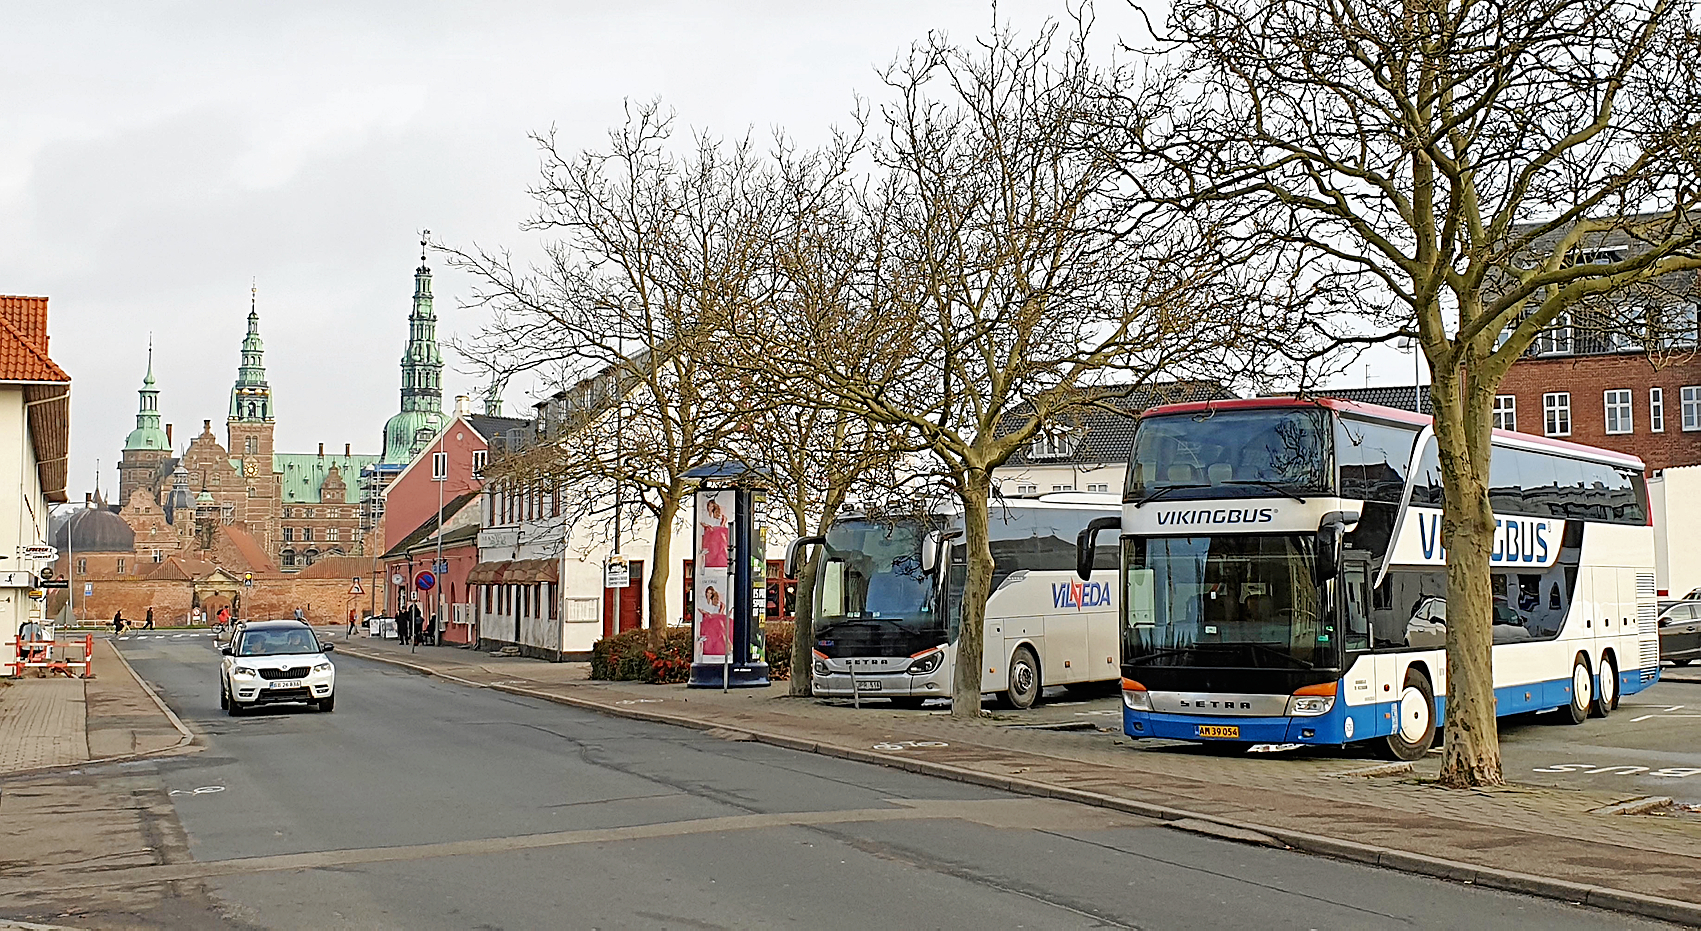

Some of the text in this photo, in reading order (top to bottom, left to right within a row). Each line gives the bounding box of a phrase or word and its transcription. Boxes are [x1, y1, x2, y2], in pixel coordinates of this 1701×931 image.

[1157, 508, 1273, 526] VIKINGBUS
[1180, 700, 1251, 710] SETRA
[1212, 727, 1222, 735] 39
